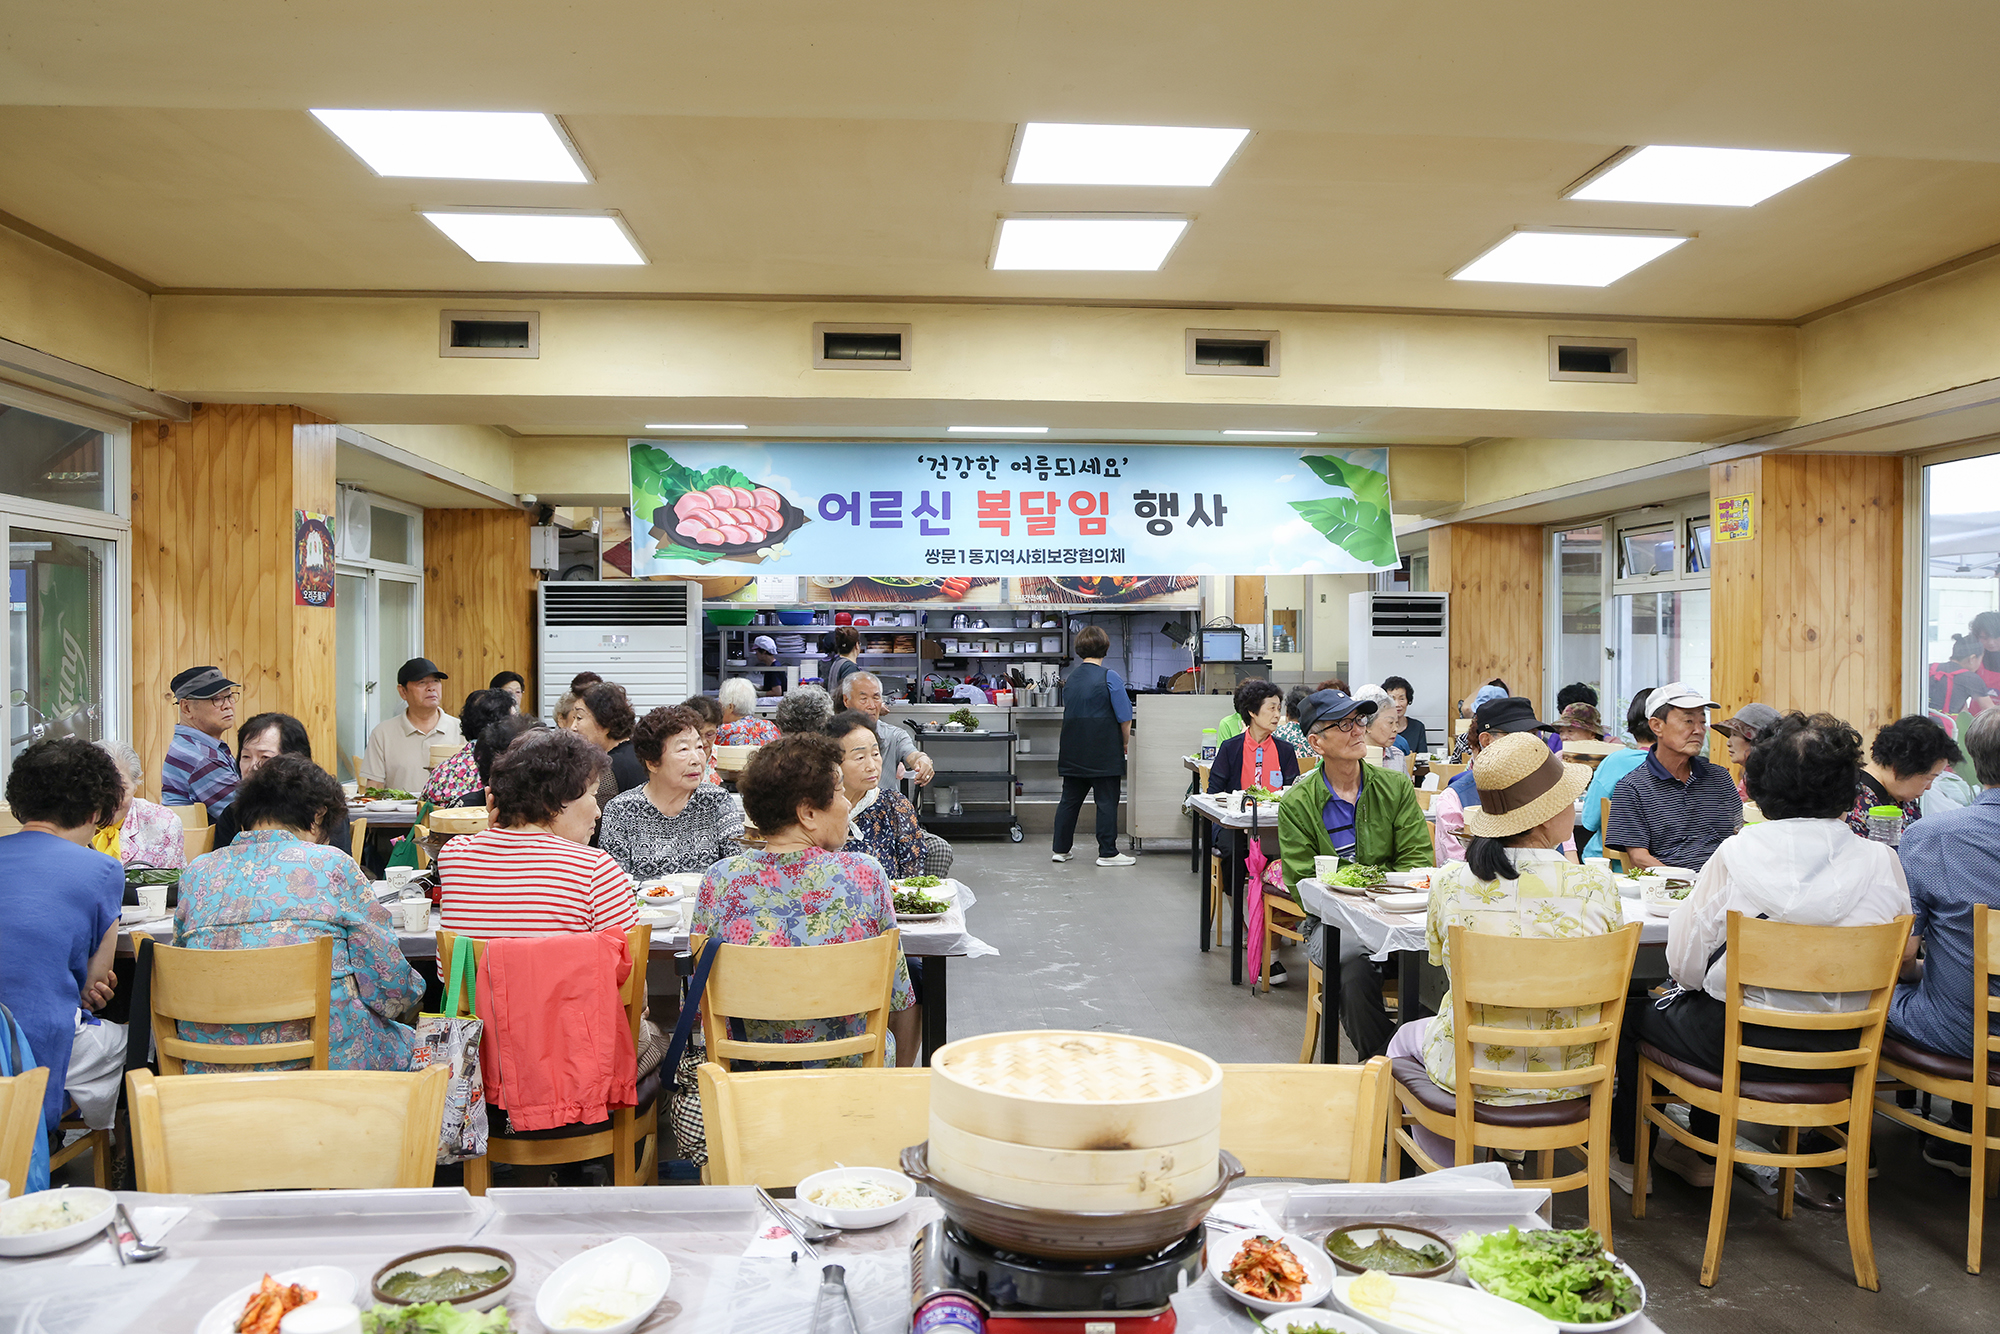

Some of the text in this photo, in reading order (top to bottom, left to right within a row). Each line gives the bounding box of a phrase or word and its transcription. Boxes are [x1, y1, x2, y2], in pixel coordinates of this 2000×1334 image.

[817, 489, 1228, 537] 어르신 복달임 행사
[924, 547, 1126, 565] 쌍문1동지역사회보장협의체
[303, 590, 327, 602] 오리주물럭
